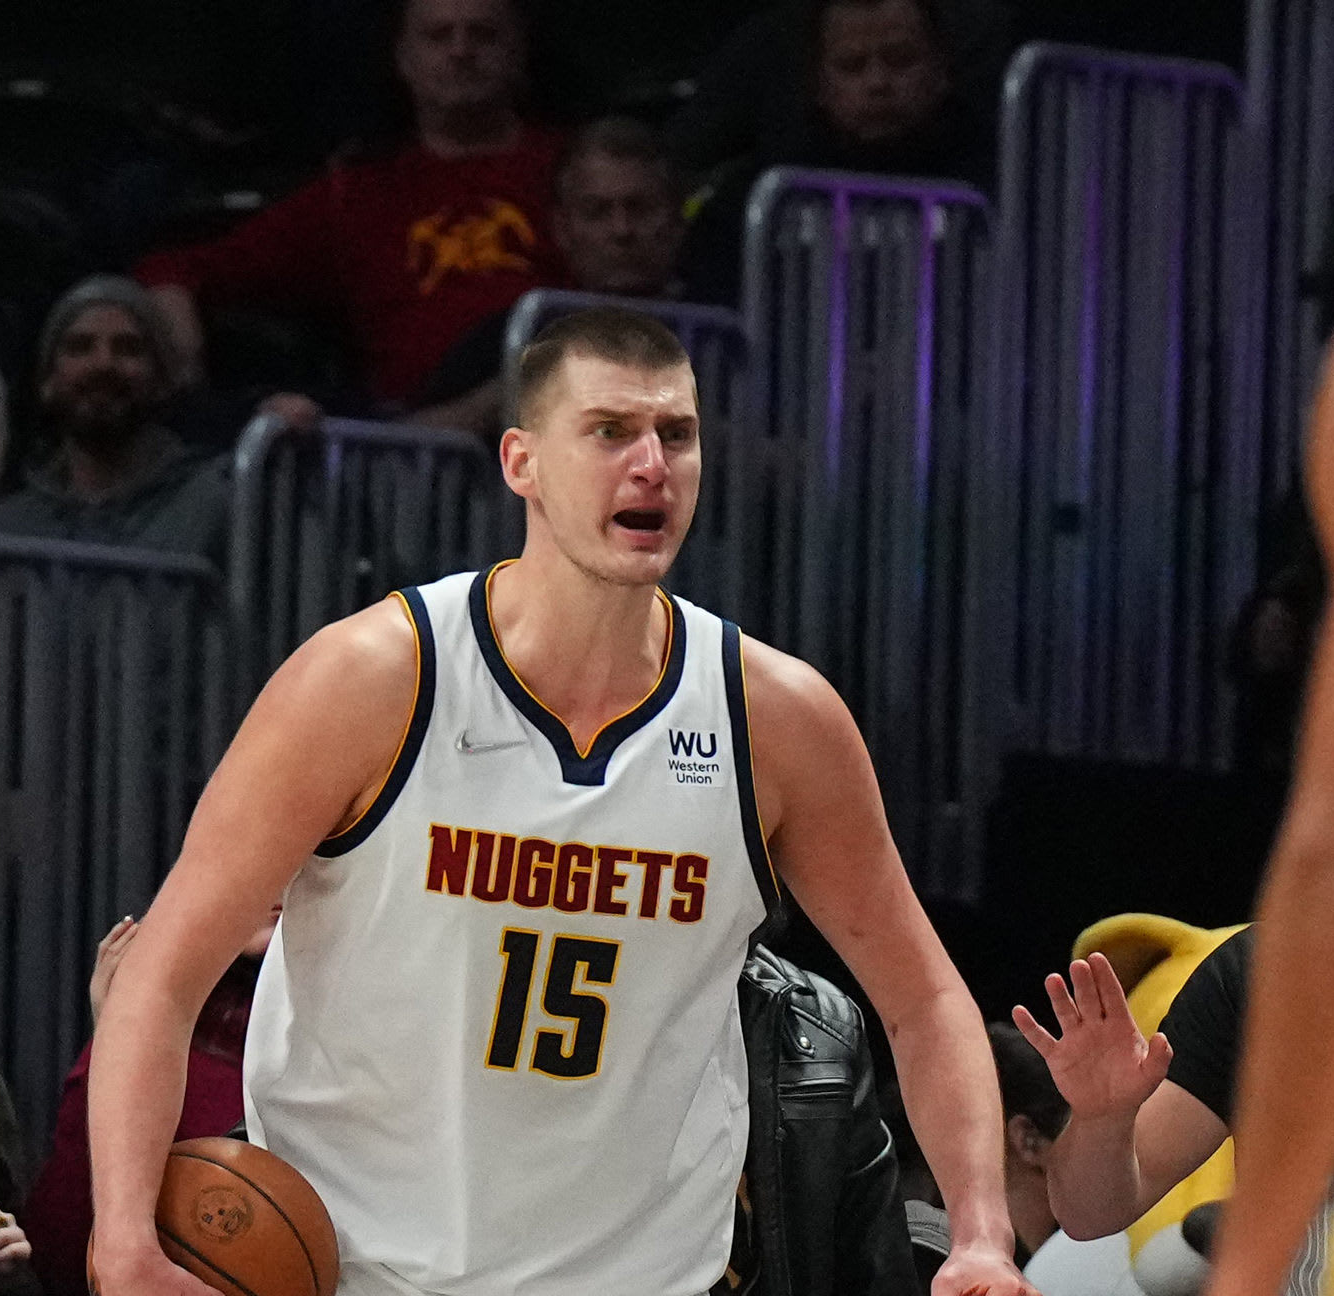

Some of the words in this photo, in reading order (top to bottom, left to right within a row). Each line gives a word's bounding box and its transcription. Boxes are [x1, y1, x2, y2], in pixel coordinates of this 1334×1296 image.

[669, 728, 717, 758] WU
[668, 759, 720, 773] Western
[676, 772, 713, 785] Union
[425, 822, 710, 924] NUGGETS
[484, 925, 622, 1081] 15
